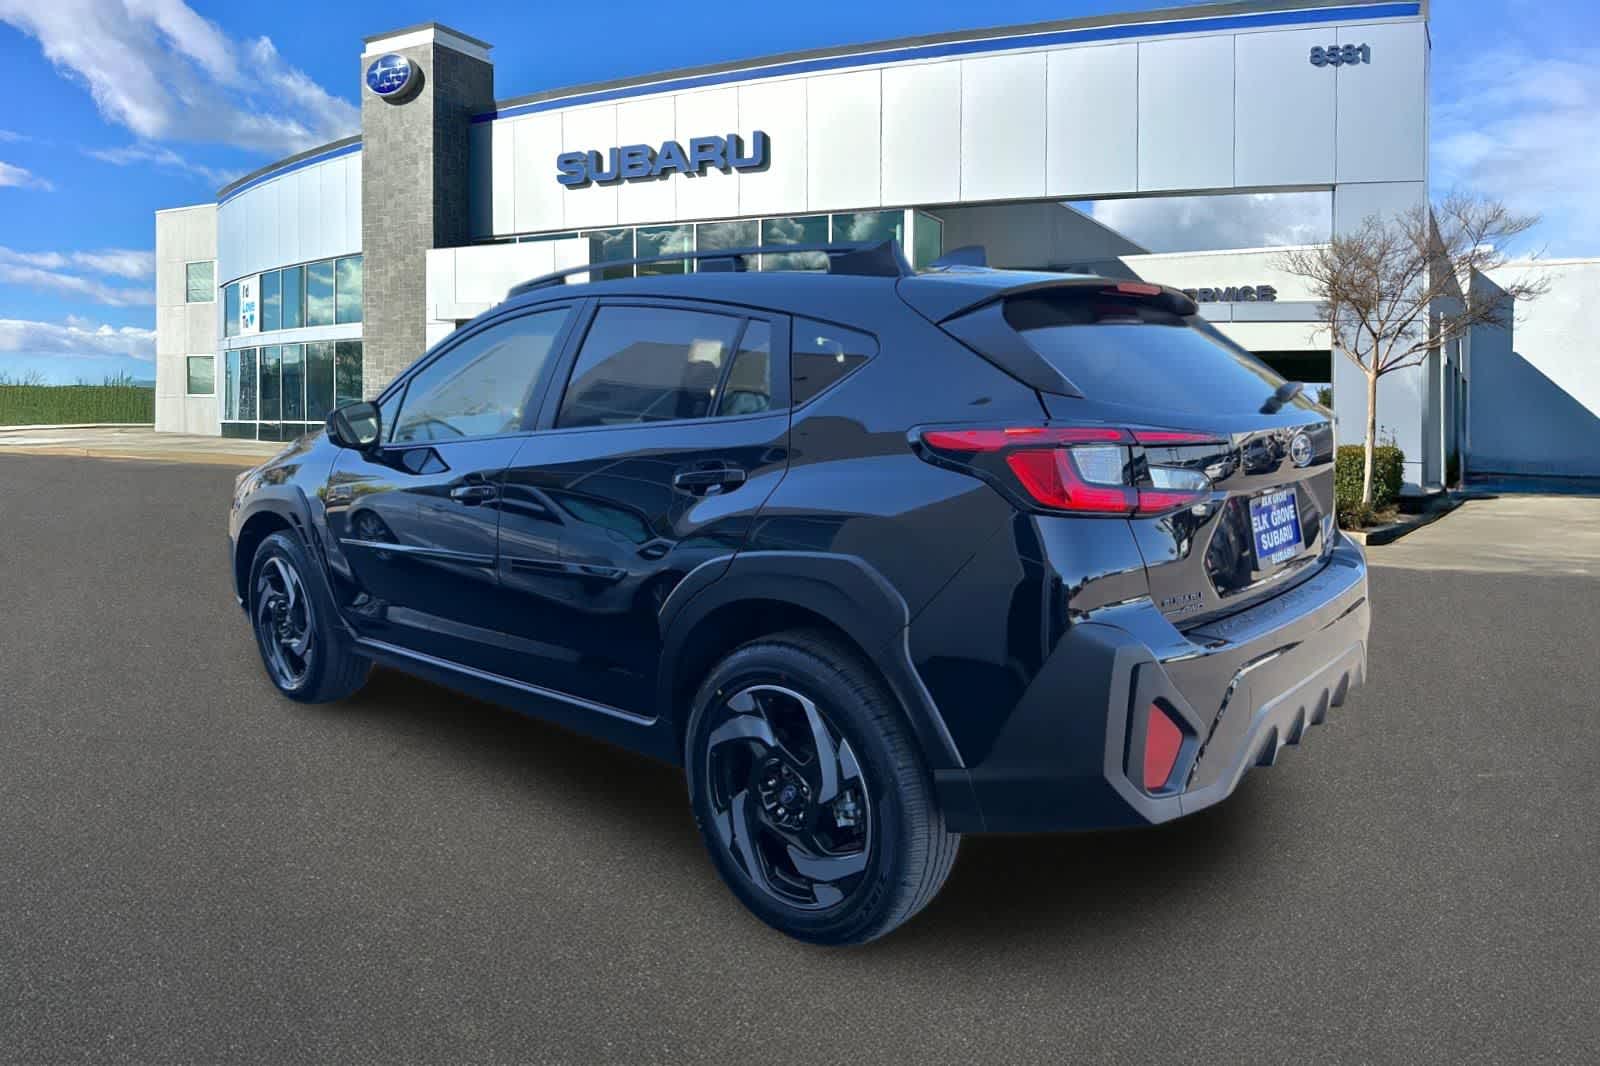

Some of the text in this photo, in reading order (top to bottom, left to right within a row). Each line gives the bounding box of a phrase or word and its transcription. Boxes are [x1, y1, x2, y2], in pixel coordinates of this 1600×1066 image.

[557, 130, 771, 190] SUBARU
[1183, 285, 1277, 302] RVICE
[1251, 504, 1295, 533] ELK GROVE
[1261, 525, 1293, 550] SUBARU
